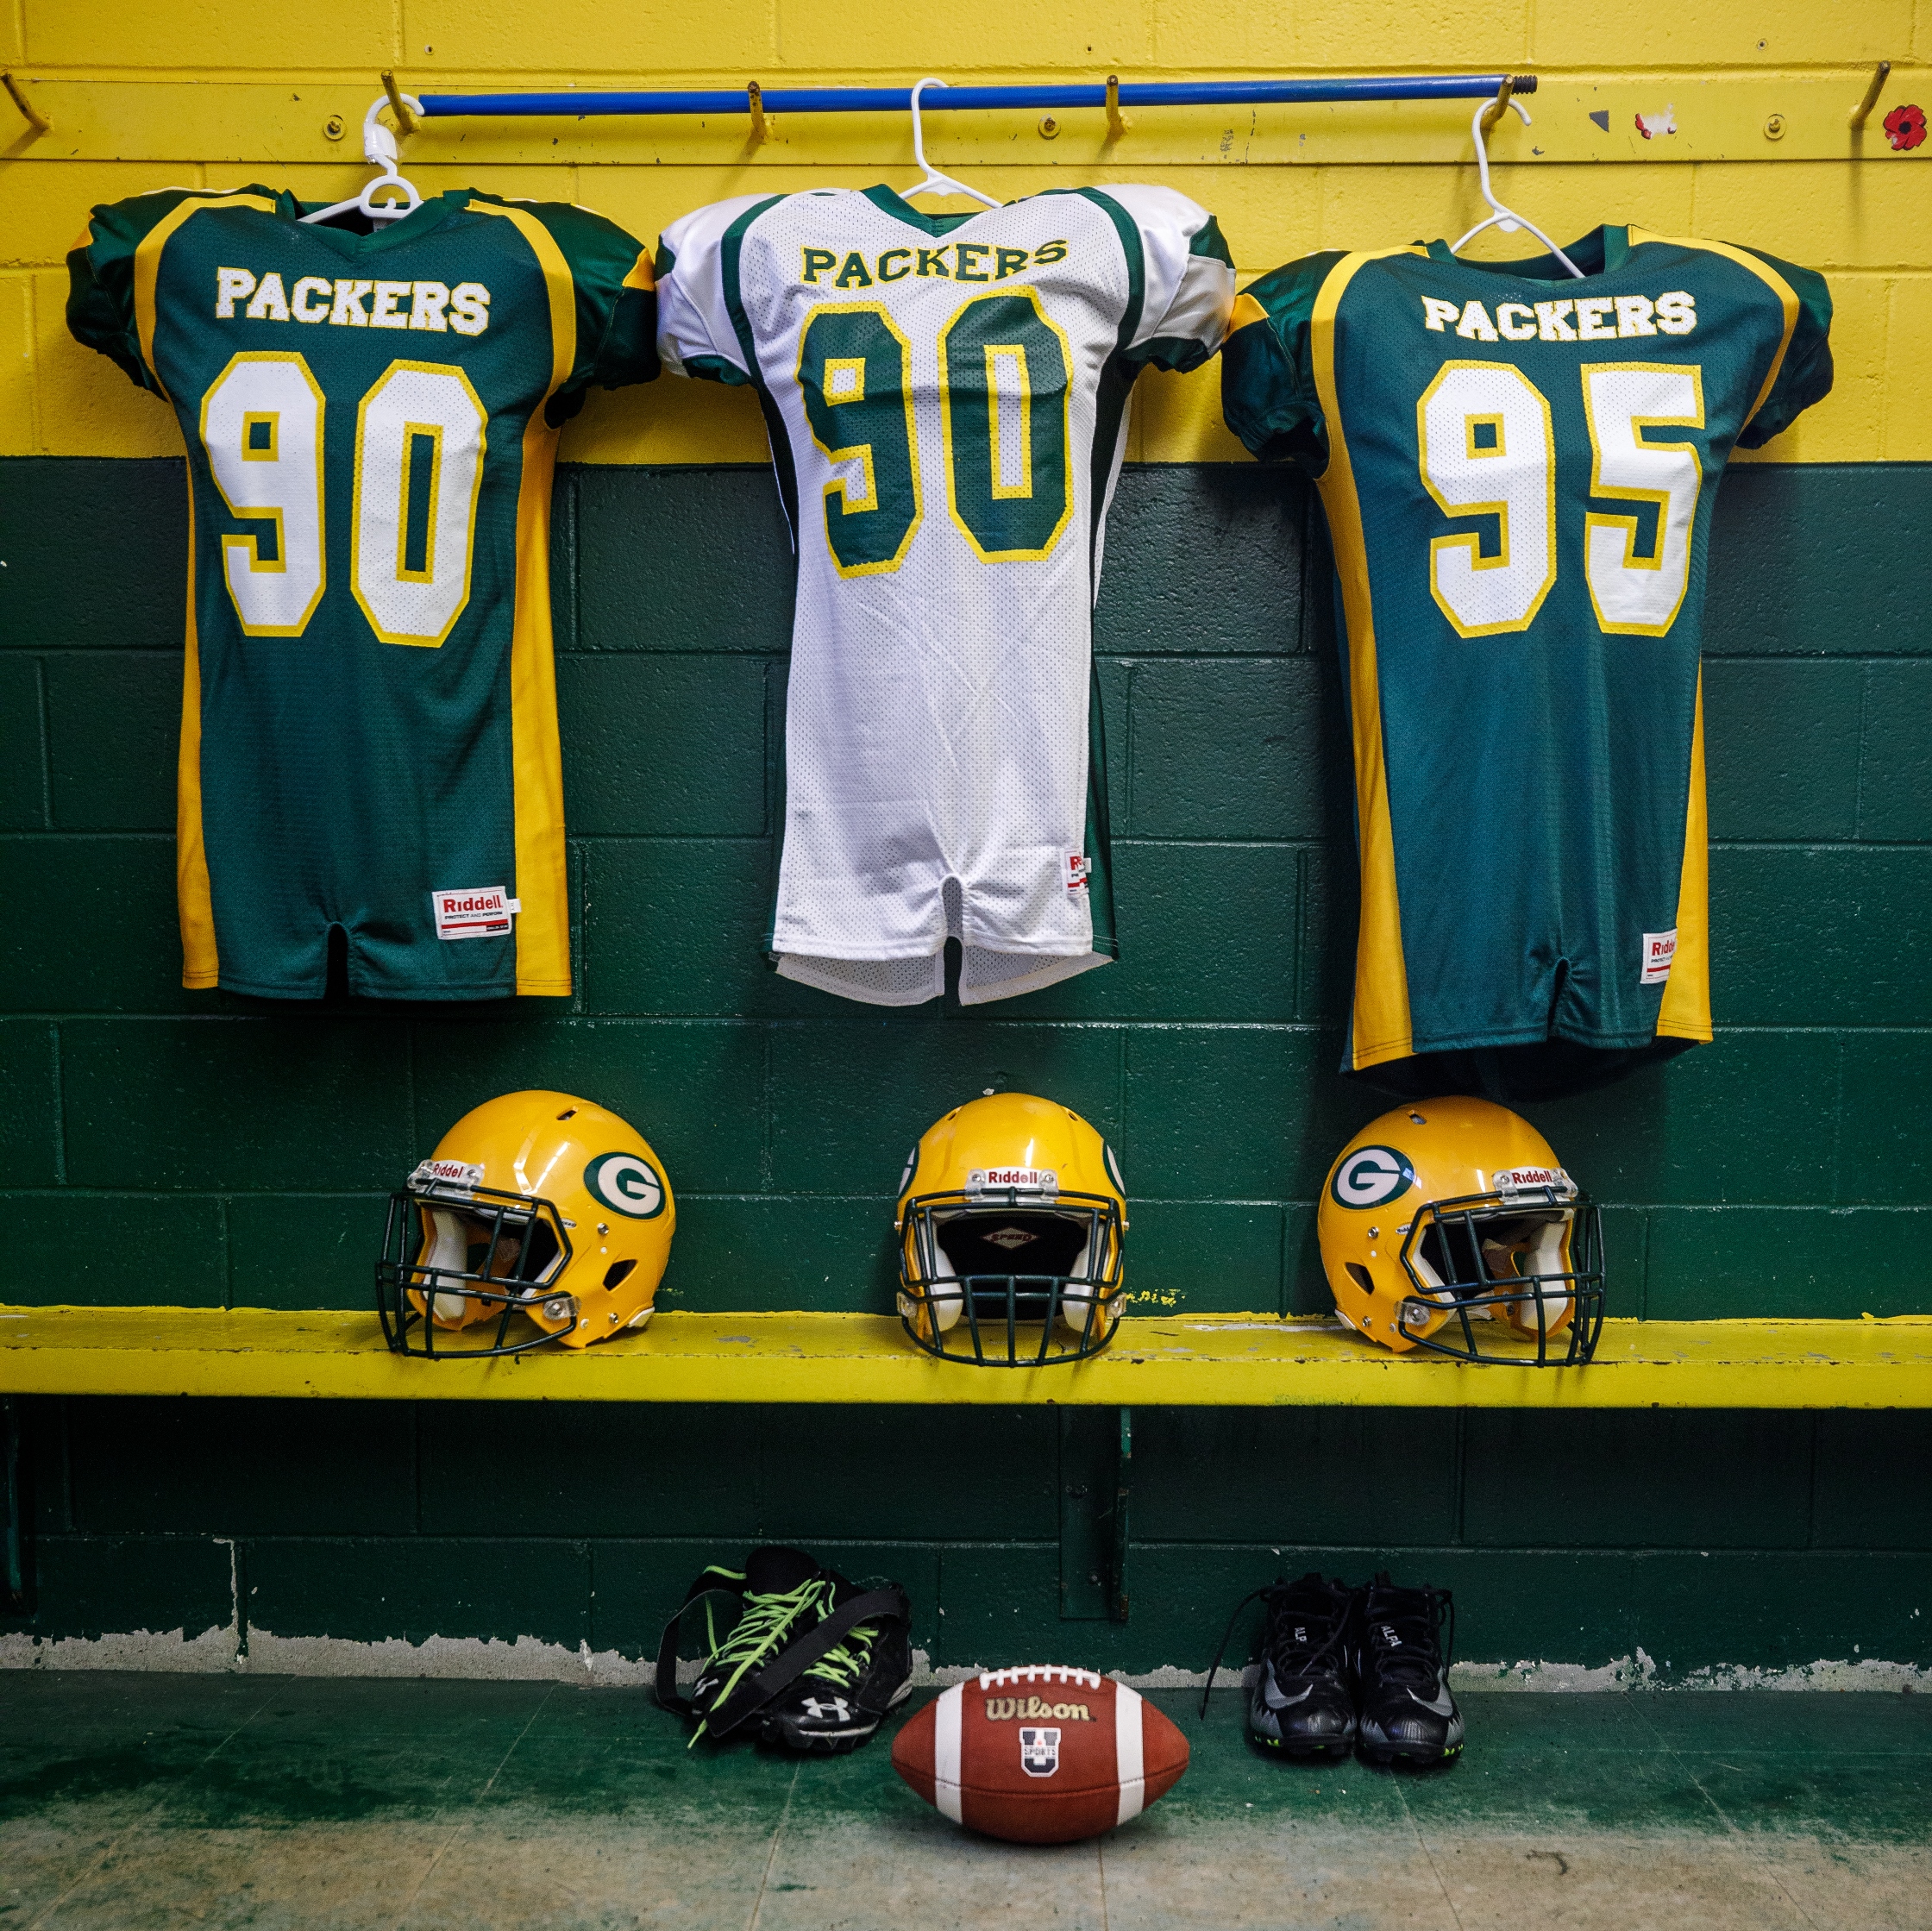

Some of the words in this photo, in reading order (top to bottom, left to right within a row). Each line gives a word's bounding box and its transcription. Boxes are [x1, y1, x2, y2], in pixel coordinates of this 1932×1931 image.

[800, 240, 1069, 291] PACKERS
[216, 266, 491, 336] PACKERS
[1421, 291, 1697, 342] PACKERS
[794, 285, 1073, 580] 90
[199, 351, 488, 649] 90
[1416, 359, 1706, 639] 95
[442, 894, 503, 913] Riddell
[597, 1156, 661, 1215] G
[988, 1170, 1038, 1185] Riddell
[1337, 1149, 1402, 1206] G
[1511, 1169, 1553, 1185] Riddell
[986, 1696, 1091, 1721] Wilson
[1024, 1746, 1057, 1756] SPORTS
